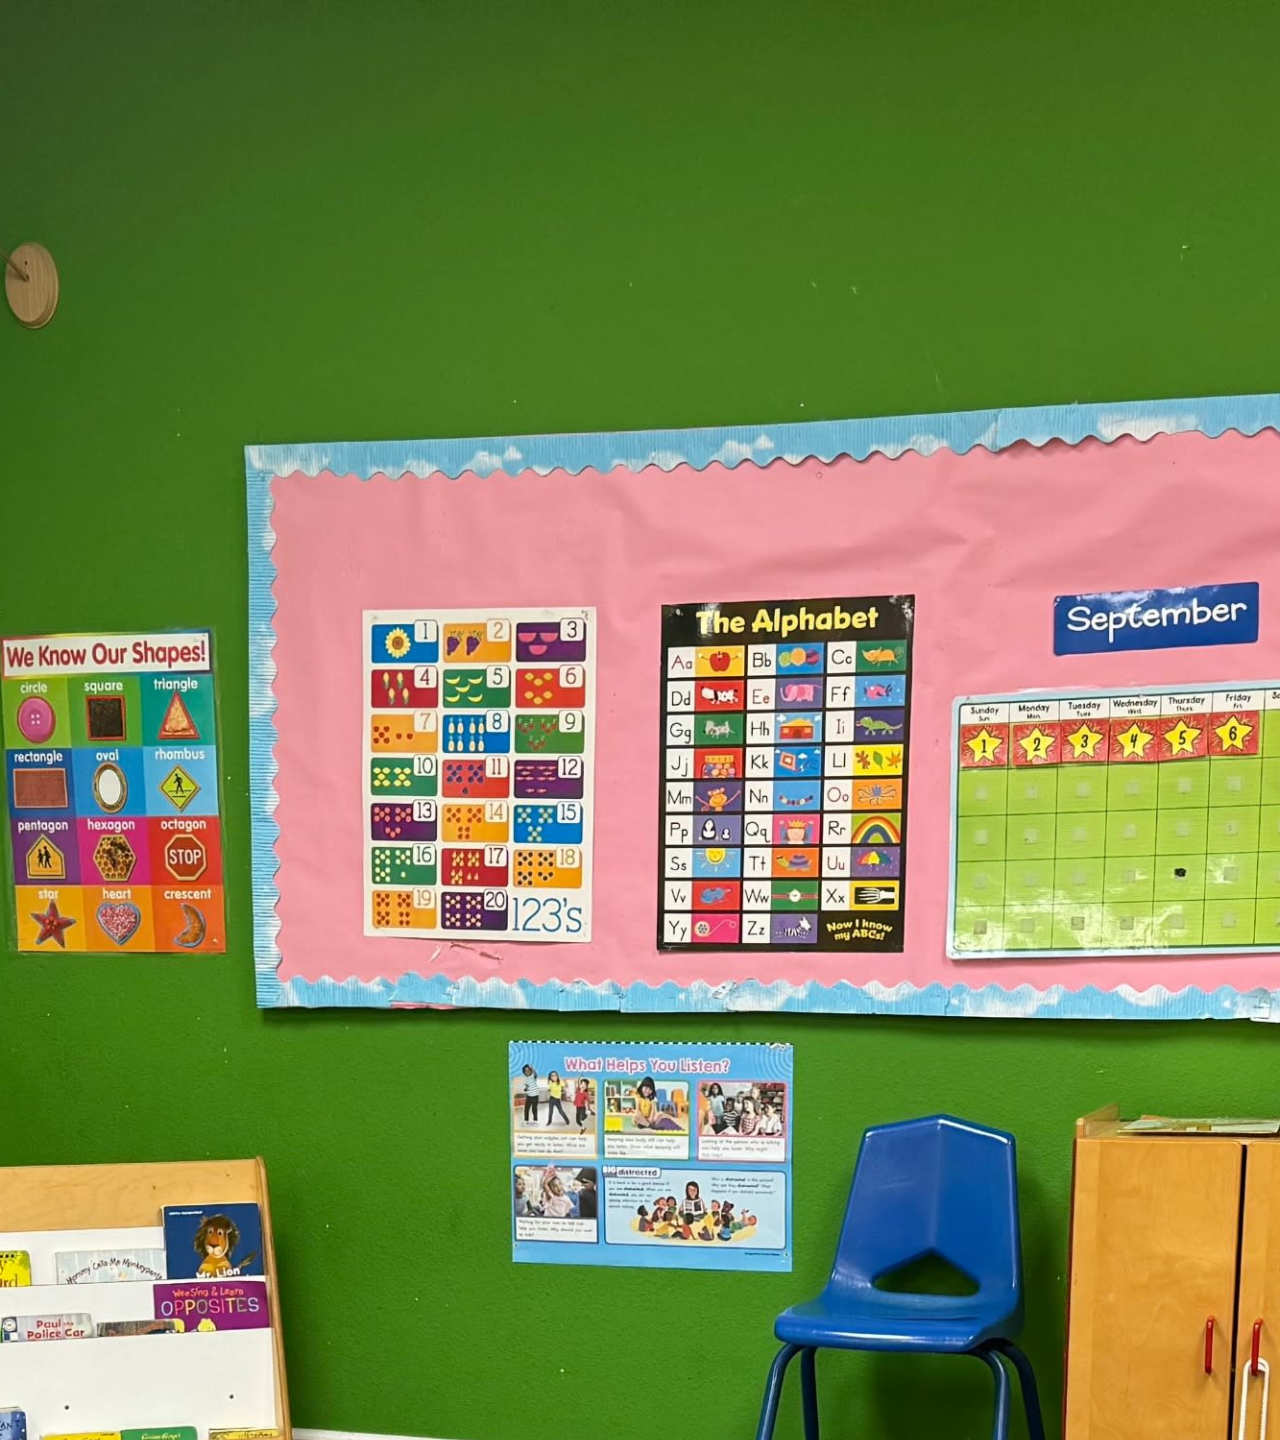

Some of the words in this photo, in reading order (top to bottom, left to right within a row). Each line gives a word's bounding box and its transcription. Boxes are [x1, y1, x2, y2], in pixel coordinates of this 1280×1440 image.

[696, 610, 745, 636] The
[752, 607, 878, 638] Alphabet
[1067, 599, 1247, 643] September
[423, 623, 428, 639] 1
[493, 622, 503, 639] 2
[567, 621, 577, 638] 3
[6, 645, 33, 668] We
[38, 643, 86, 667] Know
[92, 641, 127, 665] Our
[132, 638, 206, 666] Shapes!
[753, 652, 771, 667] Bb
[832, 651, 852, 665] Cc
[671, 655, 692, 671] Aa
[419, 668, 429, 685] 4
[492, 668, 502, 685] 5
[566, 667, 576, 684] 6
[20, 681, 47, 694] circle
[84, 681, 123, 695] square
[154, 677, 197, 693] triangle
[831, 685, 850, 701] Ff
[671, 690, 691, 706] Dd
[752, 688, 770, 704] Ee
[1113, 699, 1157, 708] Wednesday
[1169, 697, 1205, 706] Thursday
[1225, 694, 1252, 704] Friday
[970, 706, 999, 716] Sunday
[1018, 704, 1050, 714] Monday
[1068, 701, 1100, 712] Tuesday
[420, 713, 429, 729] 7
[492, 713, 502, 729] 8
[565, 713, 575, 729] 9
[751, 721, 769, 736] Hh
[670, 723, 691, 743] Gg
[1081, 734, 1089, 748] 3
[1130, 733, 1138, 747] 4
[1178, 729, 1187, 744] 5
[1228, 727, 1237, 741] 6
[981, 738, 987, 753] 1
[1033, 738, 1041, 751] 2
[14, 749, 62, 765] rectangle
[96, 749, 118, 762] oval
[155, 747, 205, 760] rhombus
[416, 758, 432, 774] 10
[491, 757, 501, 774] 11
[561, 759, 578, 776] 12
[671, 755, 688, 777] Jj
[751, 754, 769, 770] Kk
[668, 789, 691, 805] Mm
[750, 788, 768, 804] Nn
[827, 787, 848, 802] Oo
[417, 803, 432, 819] 13
[489, 803, 503, 819] 14
[561, 804, 576, 821] 15
[17, 819, 68, 836] pentagon
[87, 818, 135, 834] hexagon
[160, 818, 206, 834] octagon
[670, 822, 688, 842] Pp
[746, 821, 768, 843] Qq
[828, 820, 846, 836] Rr
[168, 847, 202, 865] STOP
[416, 846, 431, 862] 16
[488, 848, 503, 864] 17
[559, 848, 575, 865] 18
[827, 854, 845, 870] Uu
[671, 856, 687, 871] Ss
[749, 855, 766, 871] Tt
[38, 888, 58, 900] star
[102, 887, 131, 900] heart
[164, 887, 211, 900] crescent
[416, 890, 431, 906] 19
[486, 891, 504, 908] 20
[671, 888, 686, 903] Vv
[745, 888, 769, 903] Ww
[826, 887, 845, 903] Xx
[512, 897, 581, 933] 123's
[669, 920, 687, 941] Yy
[747, 920, 765, 936] Zz
[826, 921, 851, 932] Now
[853, 921, 859, 930] I
[861, 919, 892, 932] know
[834, 932, 849, 941] my
[852, 929, 885, 941] ABCs!
[565, 1057, 601, 1070] What
[607, 1059, 646, 1072] Helps
[649, 1060, 676, 1072] You
[680, 1060, 730, 1072] Listen?
[161, 1297, 259, 1315] OPPOSITES
[37, 1320, 61, 1328] Paul
[27, 1329, 61, 1339] Police
[65, 1328, 85, 1337] Car
